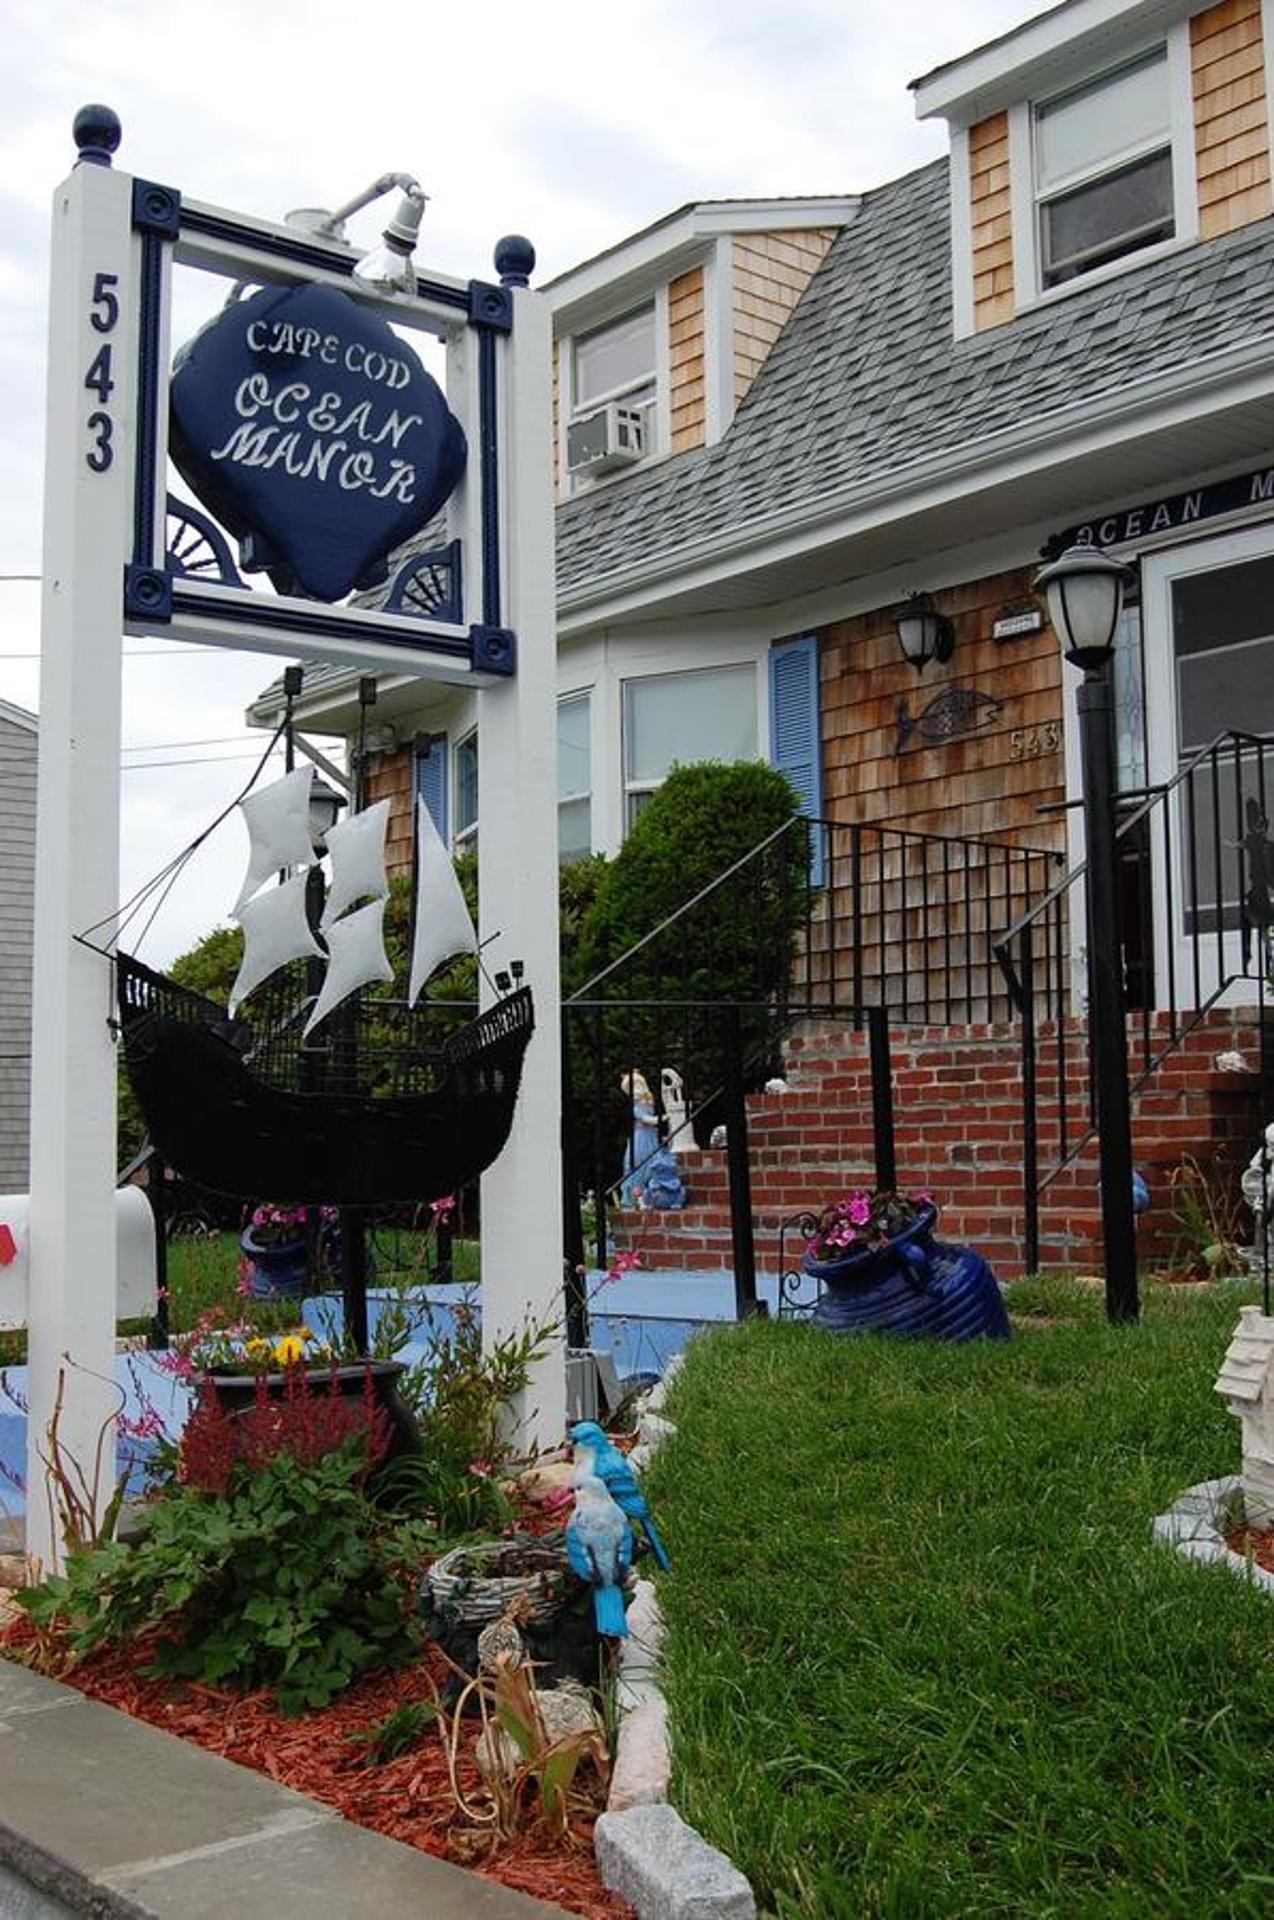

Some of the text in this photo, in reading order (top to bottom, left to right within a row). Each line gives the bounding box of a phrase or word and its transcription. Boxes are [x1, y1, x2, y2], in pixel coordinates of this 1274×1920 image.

[85, 273, 118, 473] 543
[247, 321, 410, 389] CAPE COD
[235, 373, 423, 448] OCEAN
[210, 422, 415, 503] MANOR
